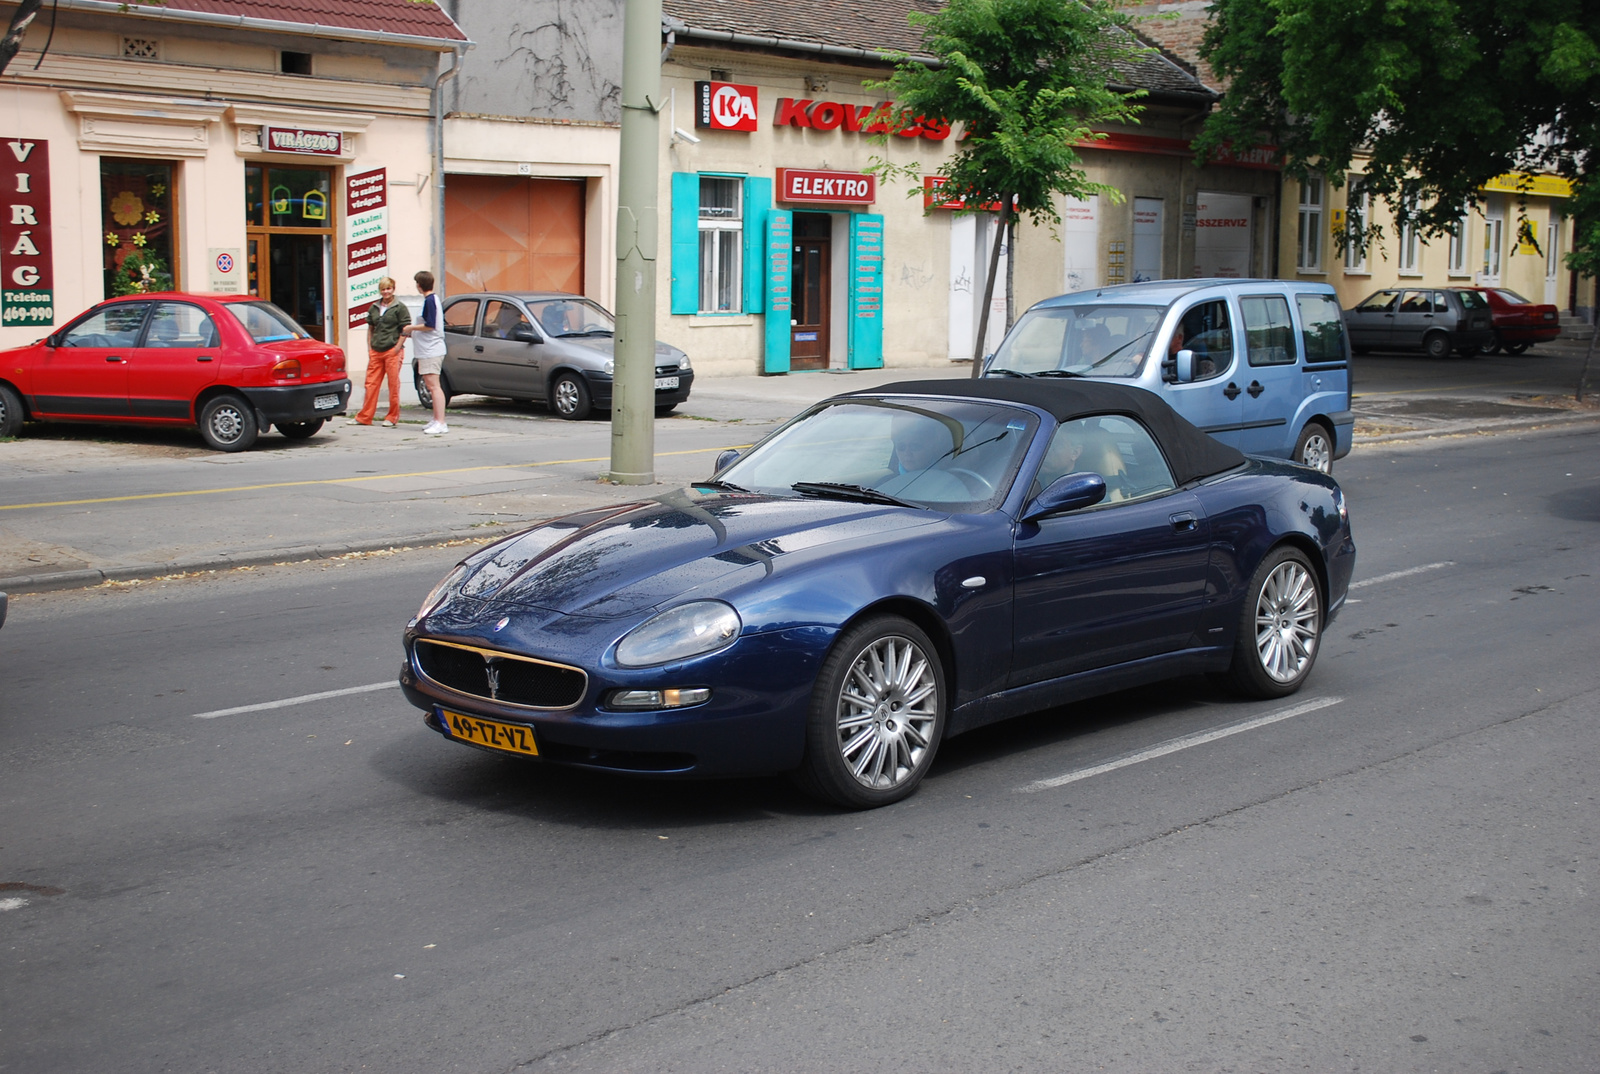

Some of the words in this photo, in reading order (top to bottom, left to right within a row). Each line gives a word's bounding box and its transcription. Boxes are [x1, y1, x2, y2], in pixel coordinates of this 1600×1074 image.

[719, 94, 757, 120] KA
[271, 130, 339, 152] VIRÁGZOO
[349, 173, 384, 188] Cserepes
[791, 177, 868, 197] ELEKTRO
[351, 195, 383, 209] virágok
[7, 141, 40, 287] VIRÁG
[352, 213, 382, 227] Alkalmi
[352, 224, 382, 238] csokrok
[4, 292, 51, 302] Telefon
[353, 289, 379, 301] csokro
[3, 306, 53, 322] 469-990
[453, 715, 531, 751] 49-TZ-VZ
